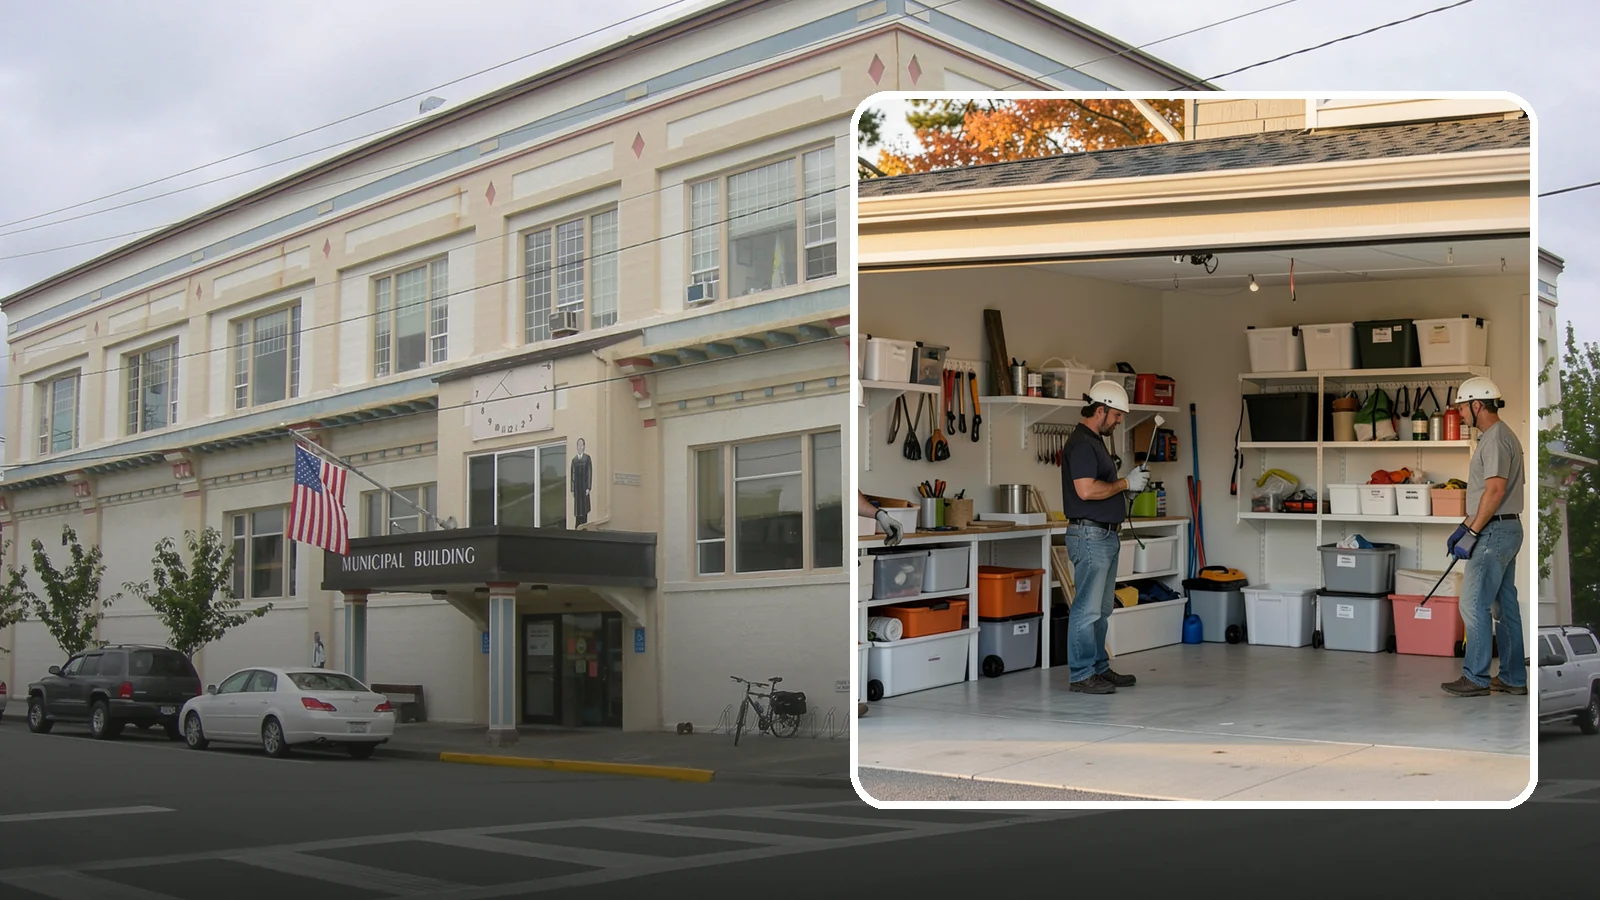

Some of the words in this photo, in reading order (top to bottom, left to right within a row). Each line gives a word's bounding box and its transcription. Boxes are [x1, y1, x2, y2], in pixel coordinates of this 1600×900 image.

[481, 406, 485, 415] 8
[488, 417, 492, 426] 9
[495, 423, 500, 431] 10
[501, 425, 506, 433] 11
[507, 425, 513, 433] 12
[521, 420, 525, 428] 2
[529, 413, 533, 422] 3
[536, 402, 540, 410] 4
[342, 553, 405, 571] MUNICIPAL
[414, 546, 475, 567] BUILDING
